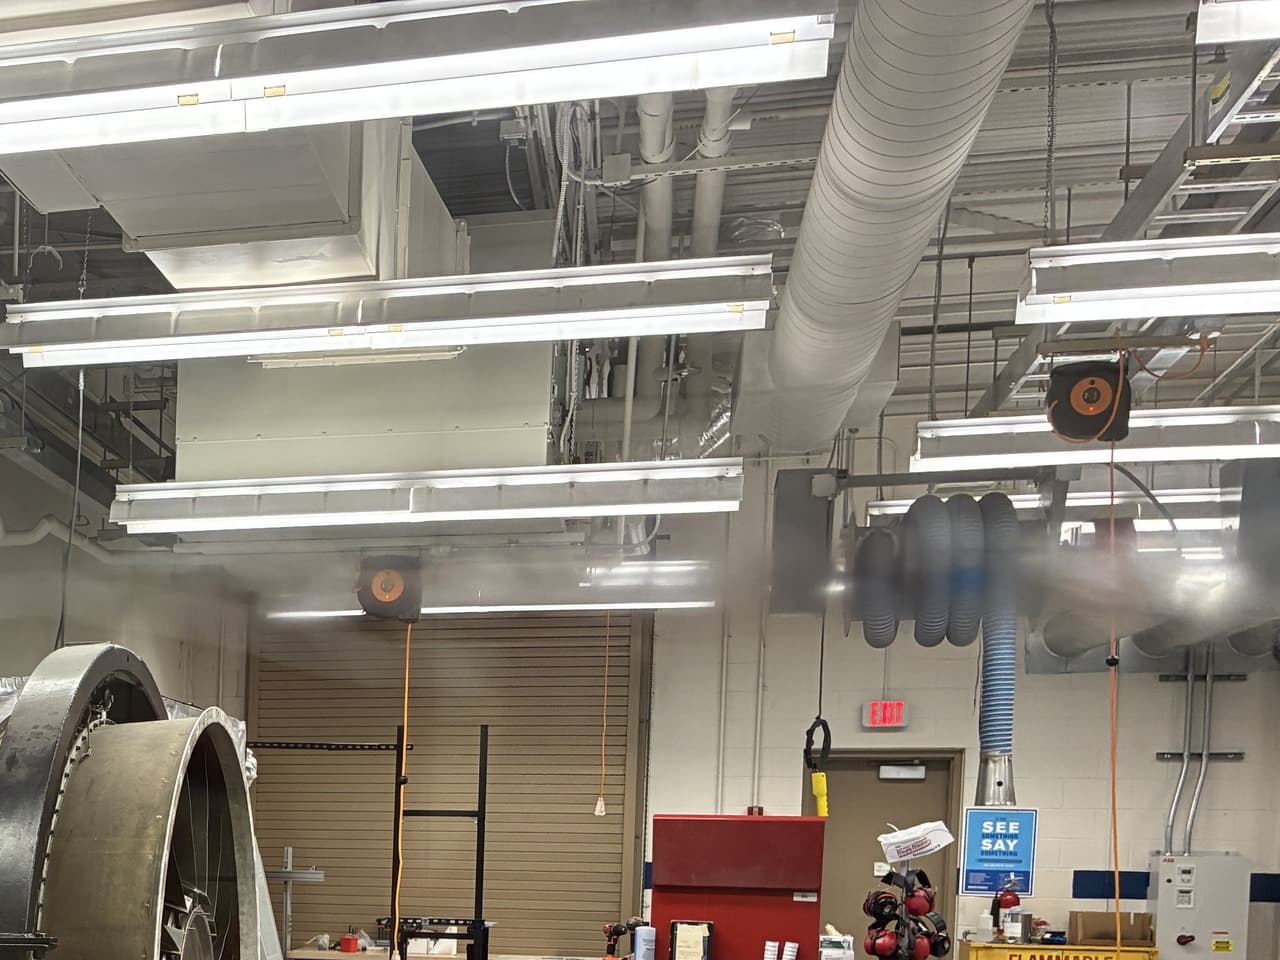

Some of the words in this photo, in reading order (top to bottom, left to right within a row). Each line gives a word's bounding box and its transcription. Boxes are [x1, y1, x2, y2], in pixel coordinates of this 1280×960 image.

[870, 701, 904, 726] EXIT
[982, 821, 1020, 833] SEE
[981, 839, 1018, 851] SAY
